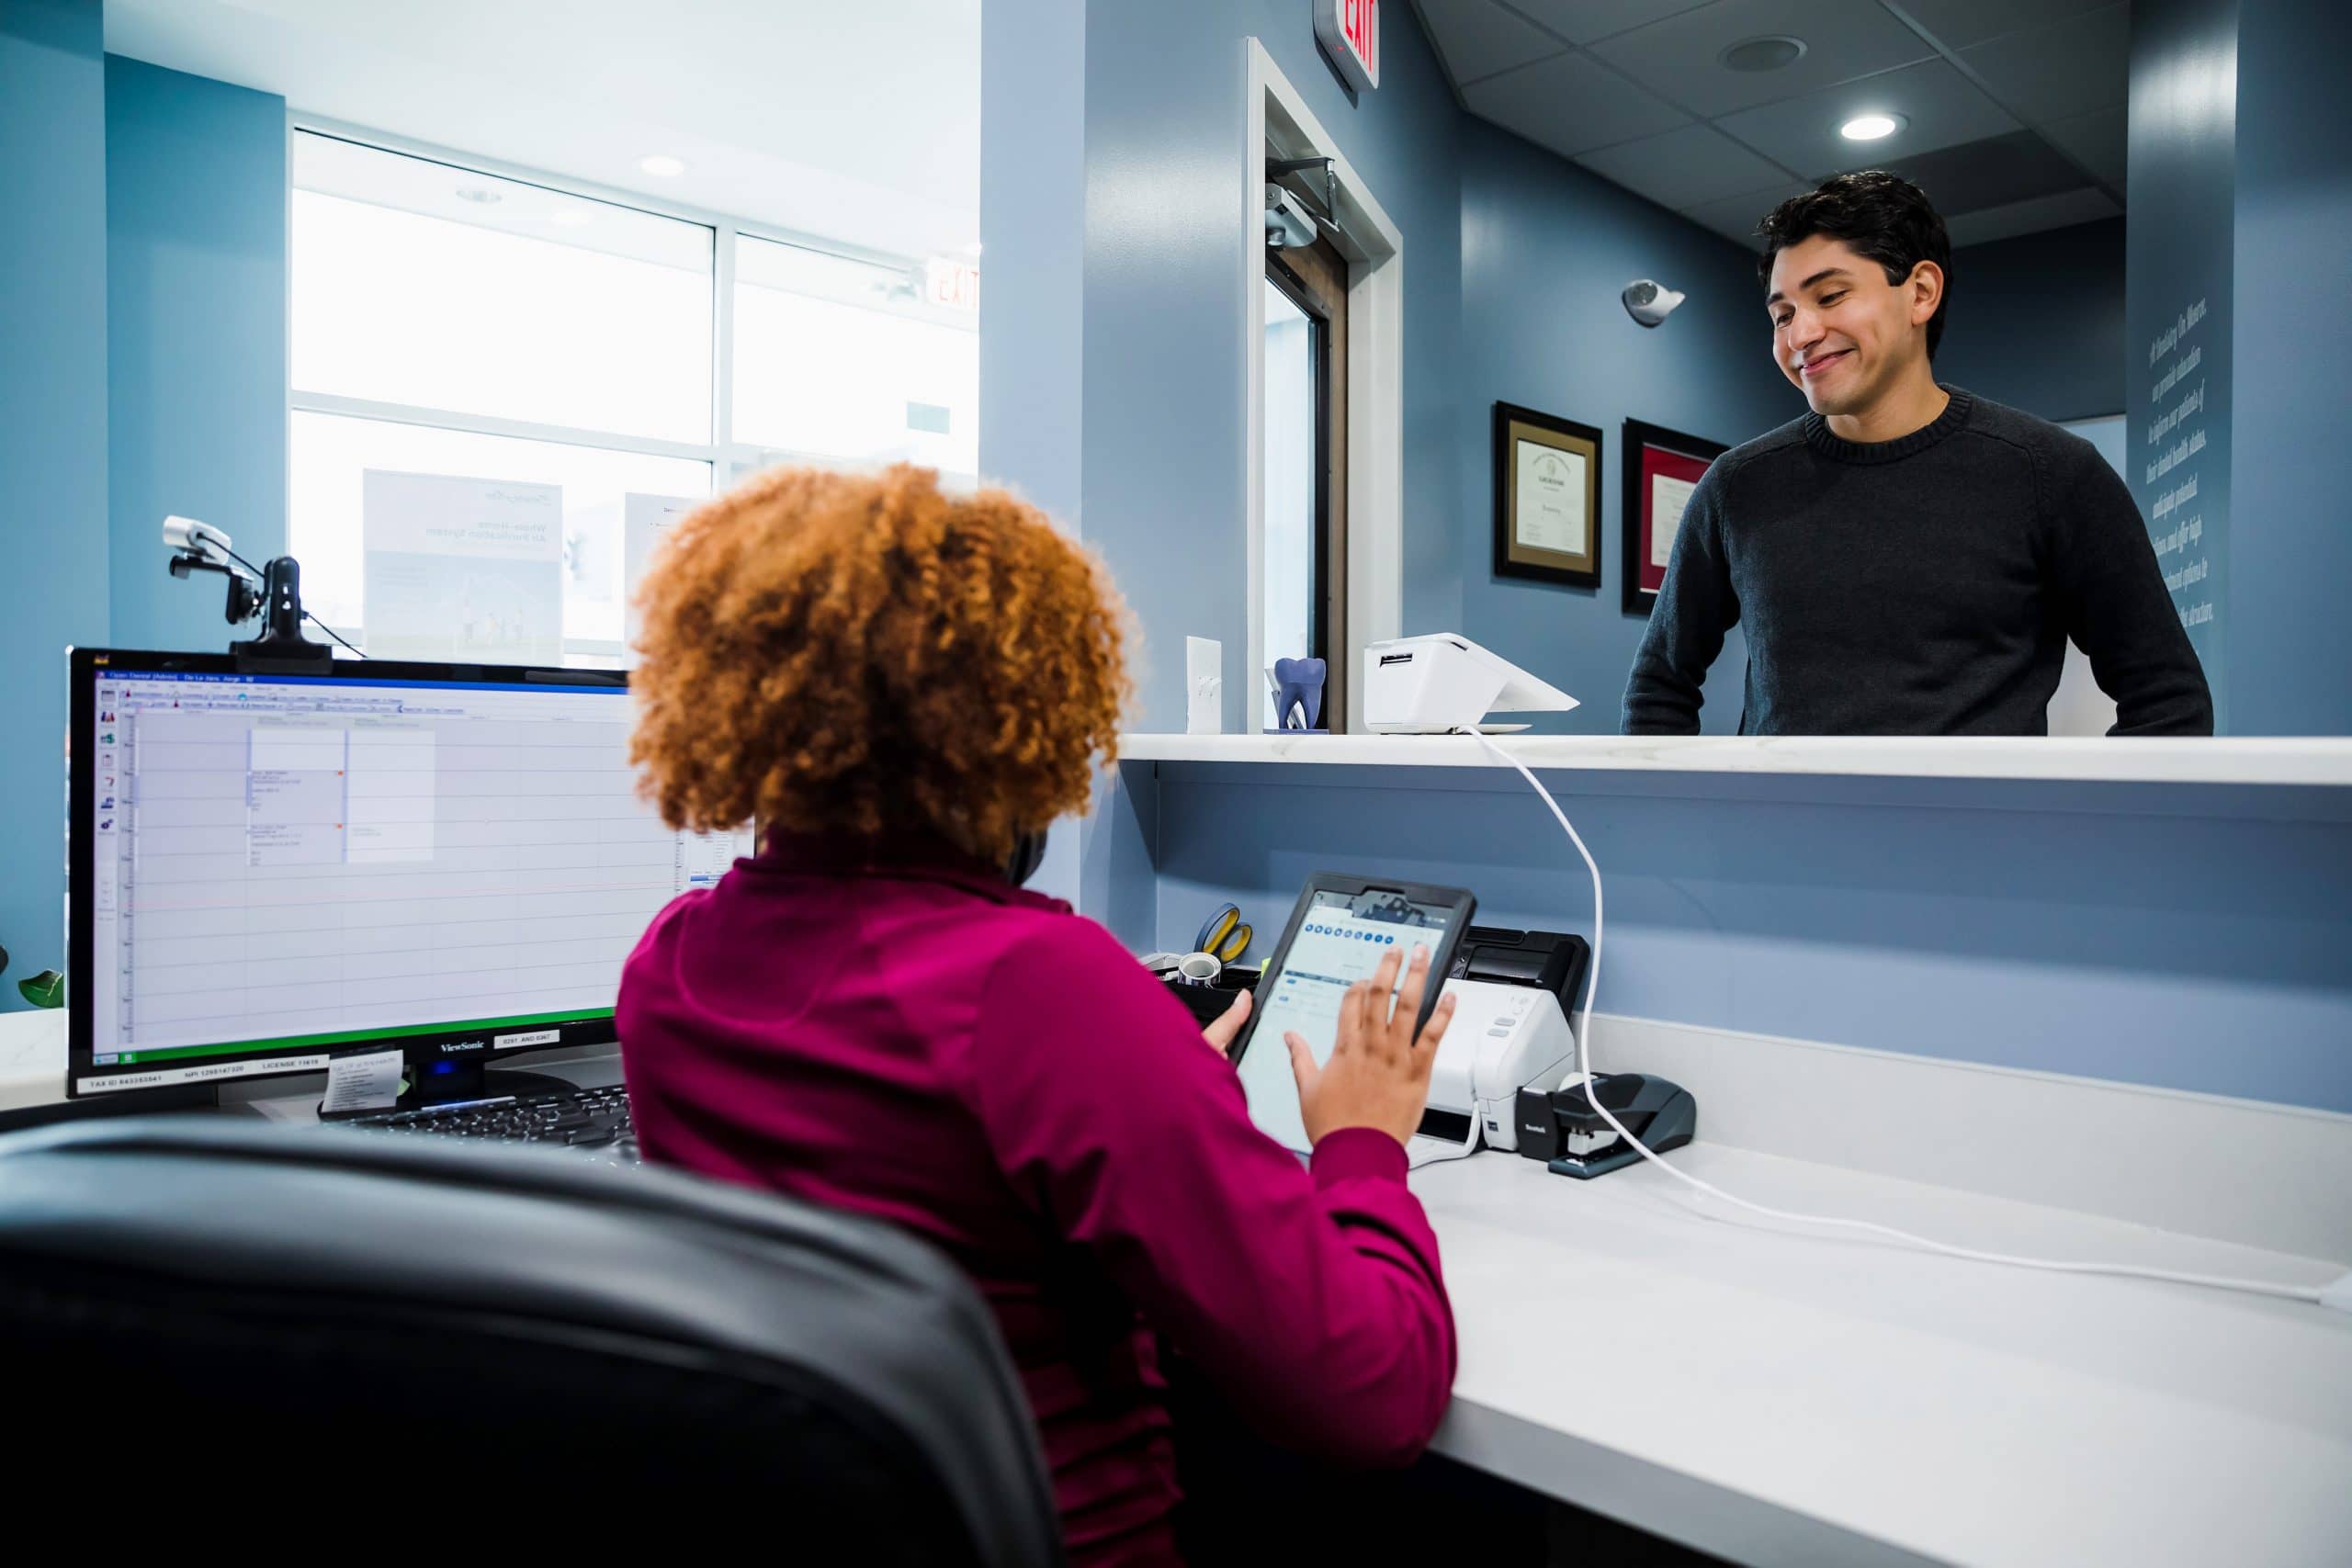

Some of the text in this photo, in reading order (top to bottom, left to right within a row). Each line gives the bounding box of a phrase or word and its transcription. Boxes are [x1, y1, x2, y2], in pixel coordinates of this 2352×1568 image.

[1345, 0, 1374, 72] EXIT
[2159, 365, 2177, 404] provide
[2177, 389, 2198, 430] patients
[441, 1040, 485, 1053] ViewSonic
[90, 1080, 106, 1089] TAX
[262, 1061, 296, 1069] LICENSE
